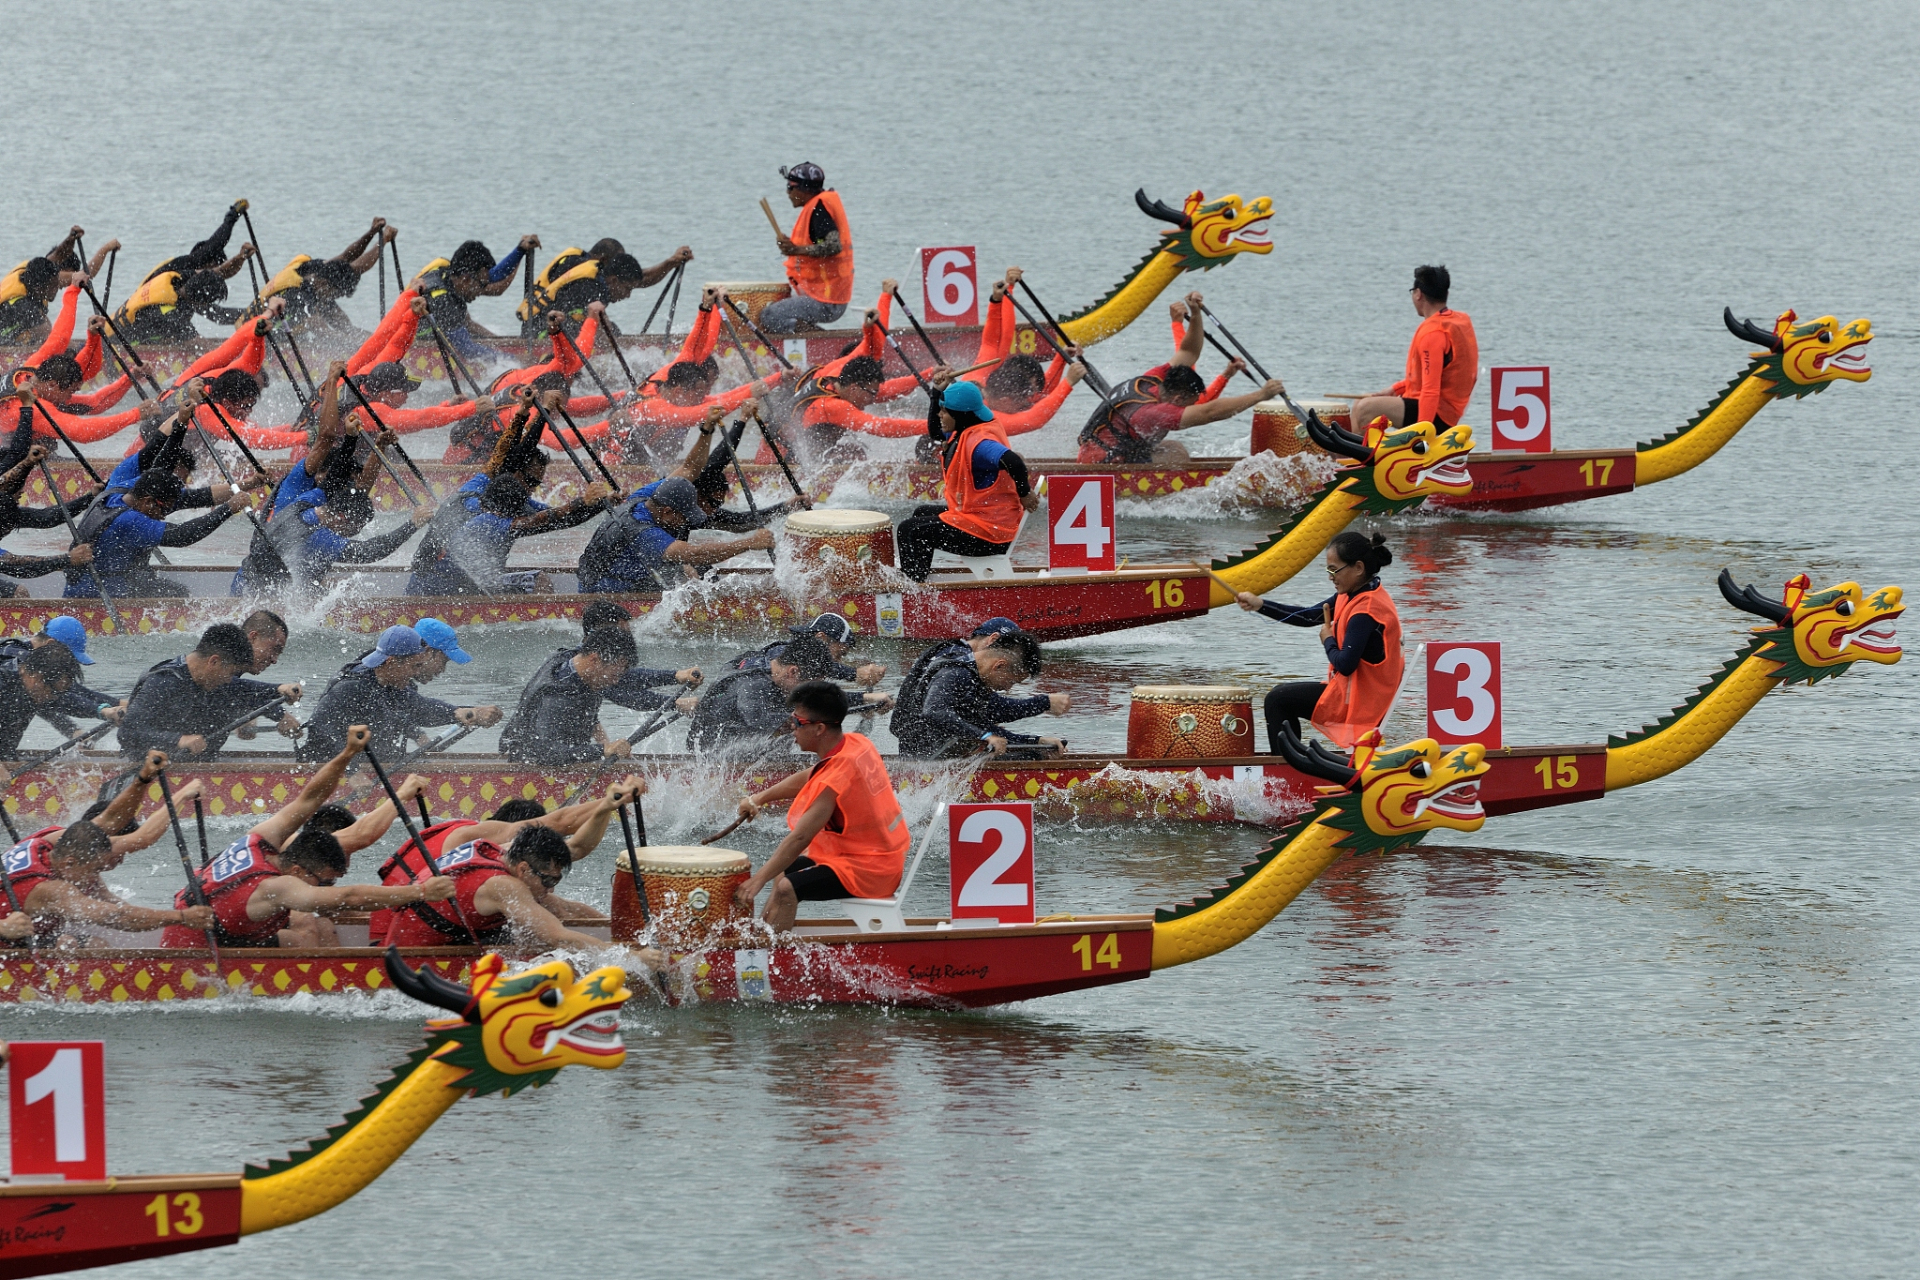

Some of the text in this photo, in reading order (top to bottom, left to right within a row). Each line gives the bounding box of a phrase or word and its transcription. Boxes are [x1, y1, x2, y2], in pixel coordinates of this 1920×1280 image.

[926, 250, 974, 317] 6
[1496, 371, 1546, 441] 5
[1488, 480, 1520, 491] Racing
[1579, 459, 1615, 487] 17
[1054, 481, 1110, 558] 4
[1145, 579, 1184, 609] 16
[1432, 647, 1495, 736] 3
[1534, 755, 1579, 790] 15
[957, 810, 1028, 907] 2
[1072, 933, 1122, 971] 14
[907, 964, 989, 983] Swift Racing
[25, 1049, 86, 1162] 1
[14, 1225, 66, 1242] Racing
[145, 1192, 204, 1237] 13
